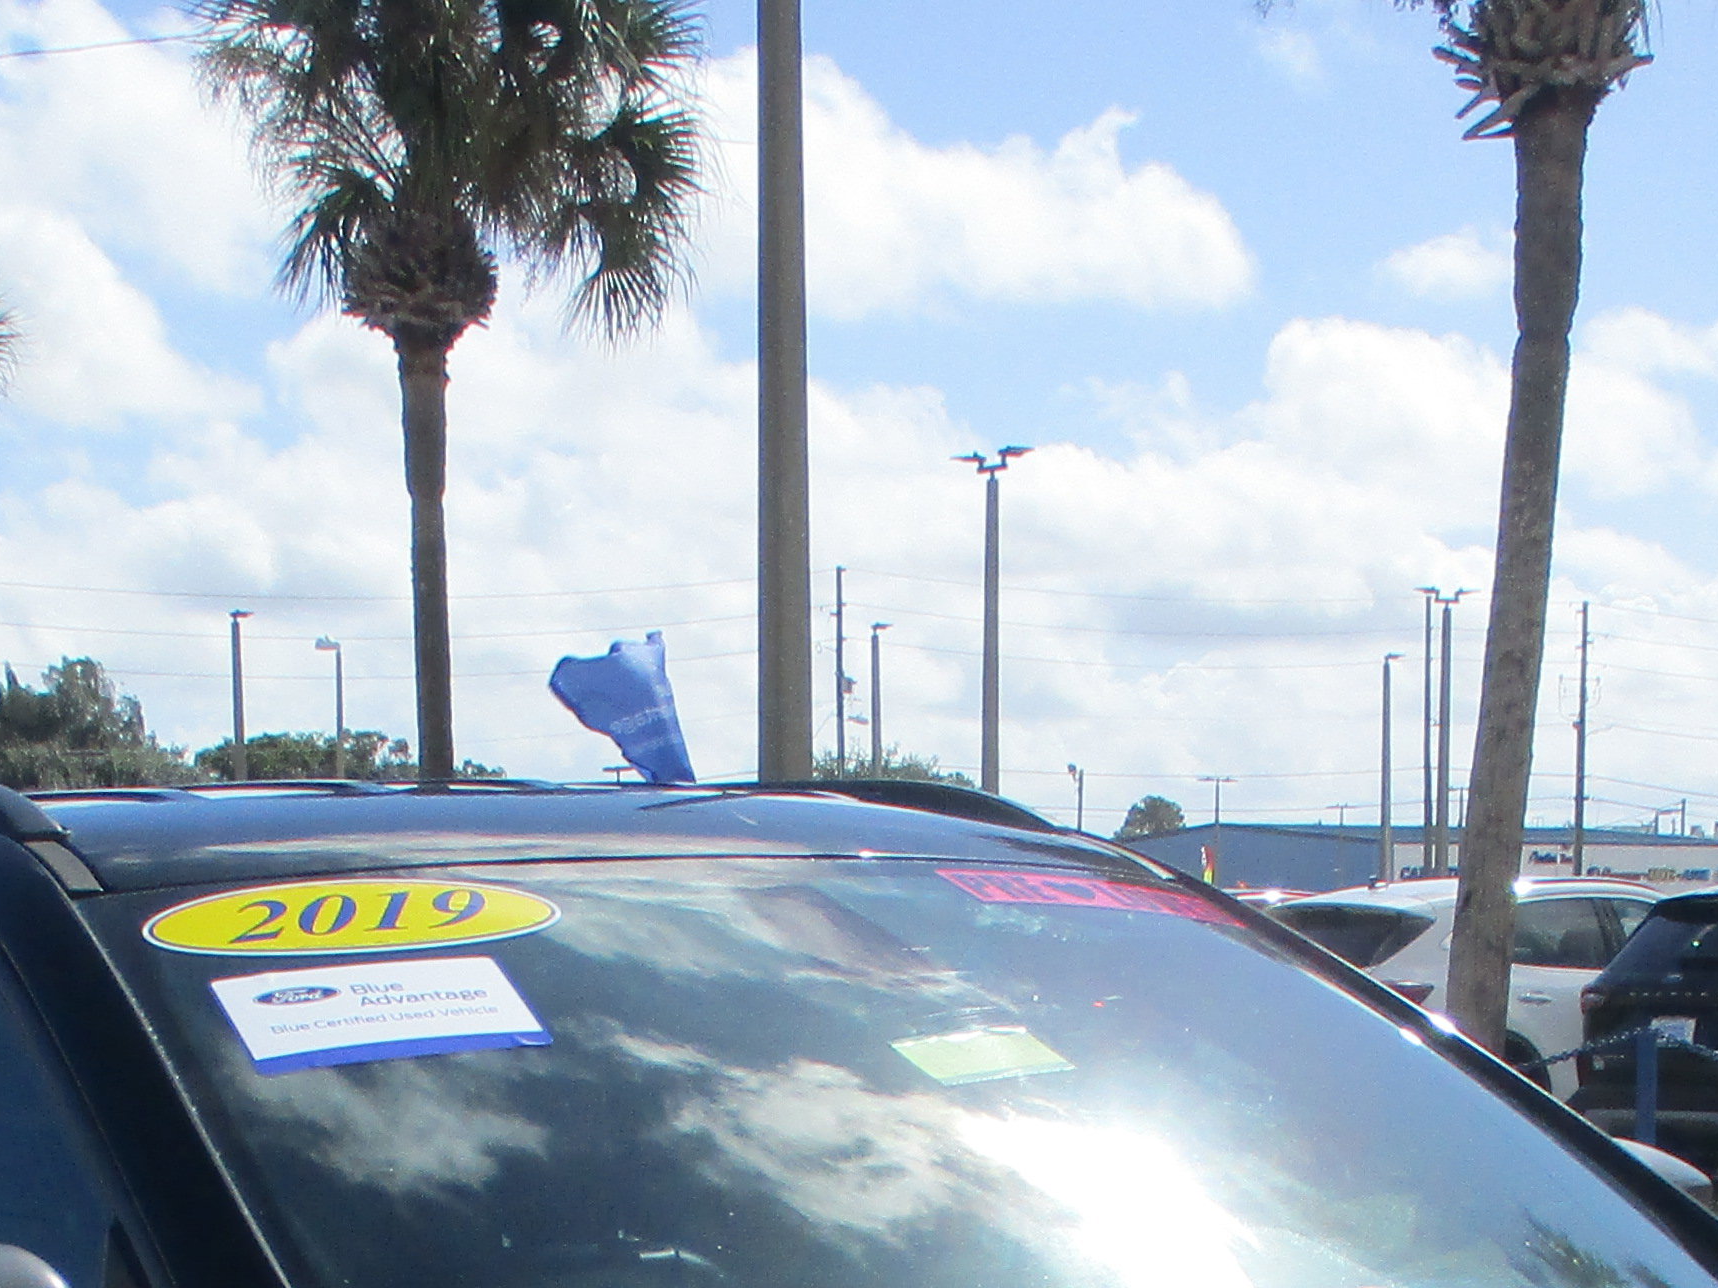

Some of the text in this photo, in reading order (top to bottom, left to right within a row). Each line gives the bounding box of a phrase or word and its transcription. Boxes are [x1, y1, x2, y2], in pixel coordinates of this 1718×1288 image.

[227, 888, 486, 944] 2019
[272, 988, 323, 1004] Ford
[349, 982, 404, 995] Blue
[361, 989, 488, 1006] Advantage
[270, 1005, 499, 1035] Blue Certified Used Vehicle
